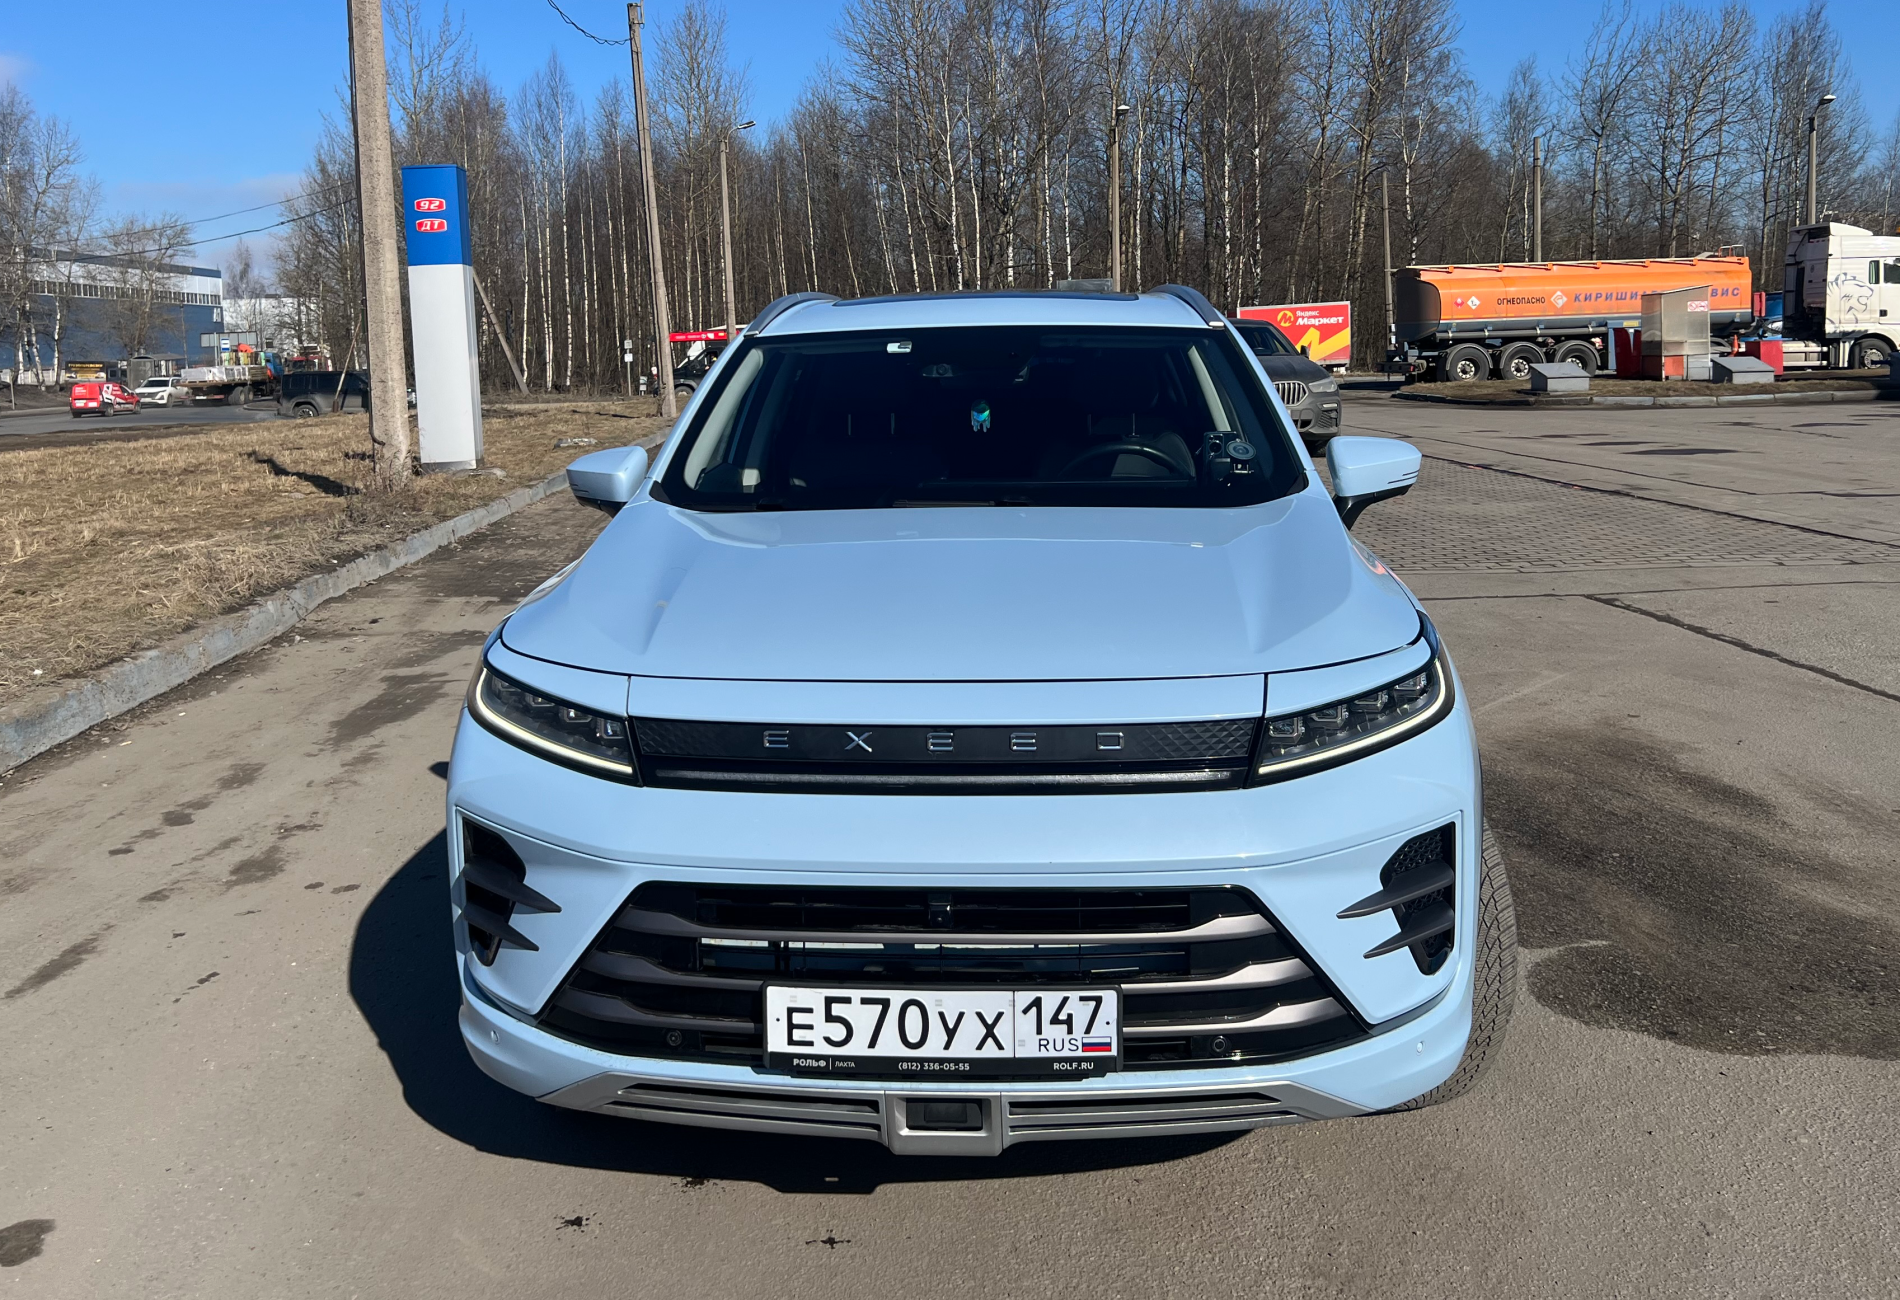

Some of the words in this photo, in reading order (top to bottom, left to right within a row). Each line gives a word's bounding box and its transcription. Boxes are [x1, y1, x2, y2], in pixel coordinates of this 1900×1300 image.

[420, 201, 439, 209] 92
[421, 221, 440, 230] ДТ
[1496, 296, 1546, 306] ОГНЕОПАСНО
[1296, 316, 1344, 325] Маркет
[762, 729, 1126, 754] EXEED
[1021, 995, 1104, 1036] 147
[1037, 1037, 1080, 1053] RUS
[793, 1058, 827, 1068] РОЛЬФ
[834, 1060, 856, 1068] ЛАХТА
[898, 1061, 921, 1071] (812)
[923, 1062, 970, 1071] 336-05-55
[1053, 1061, 1095, 1070] ROLF.RU
